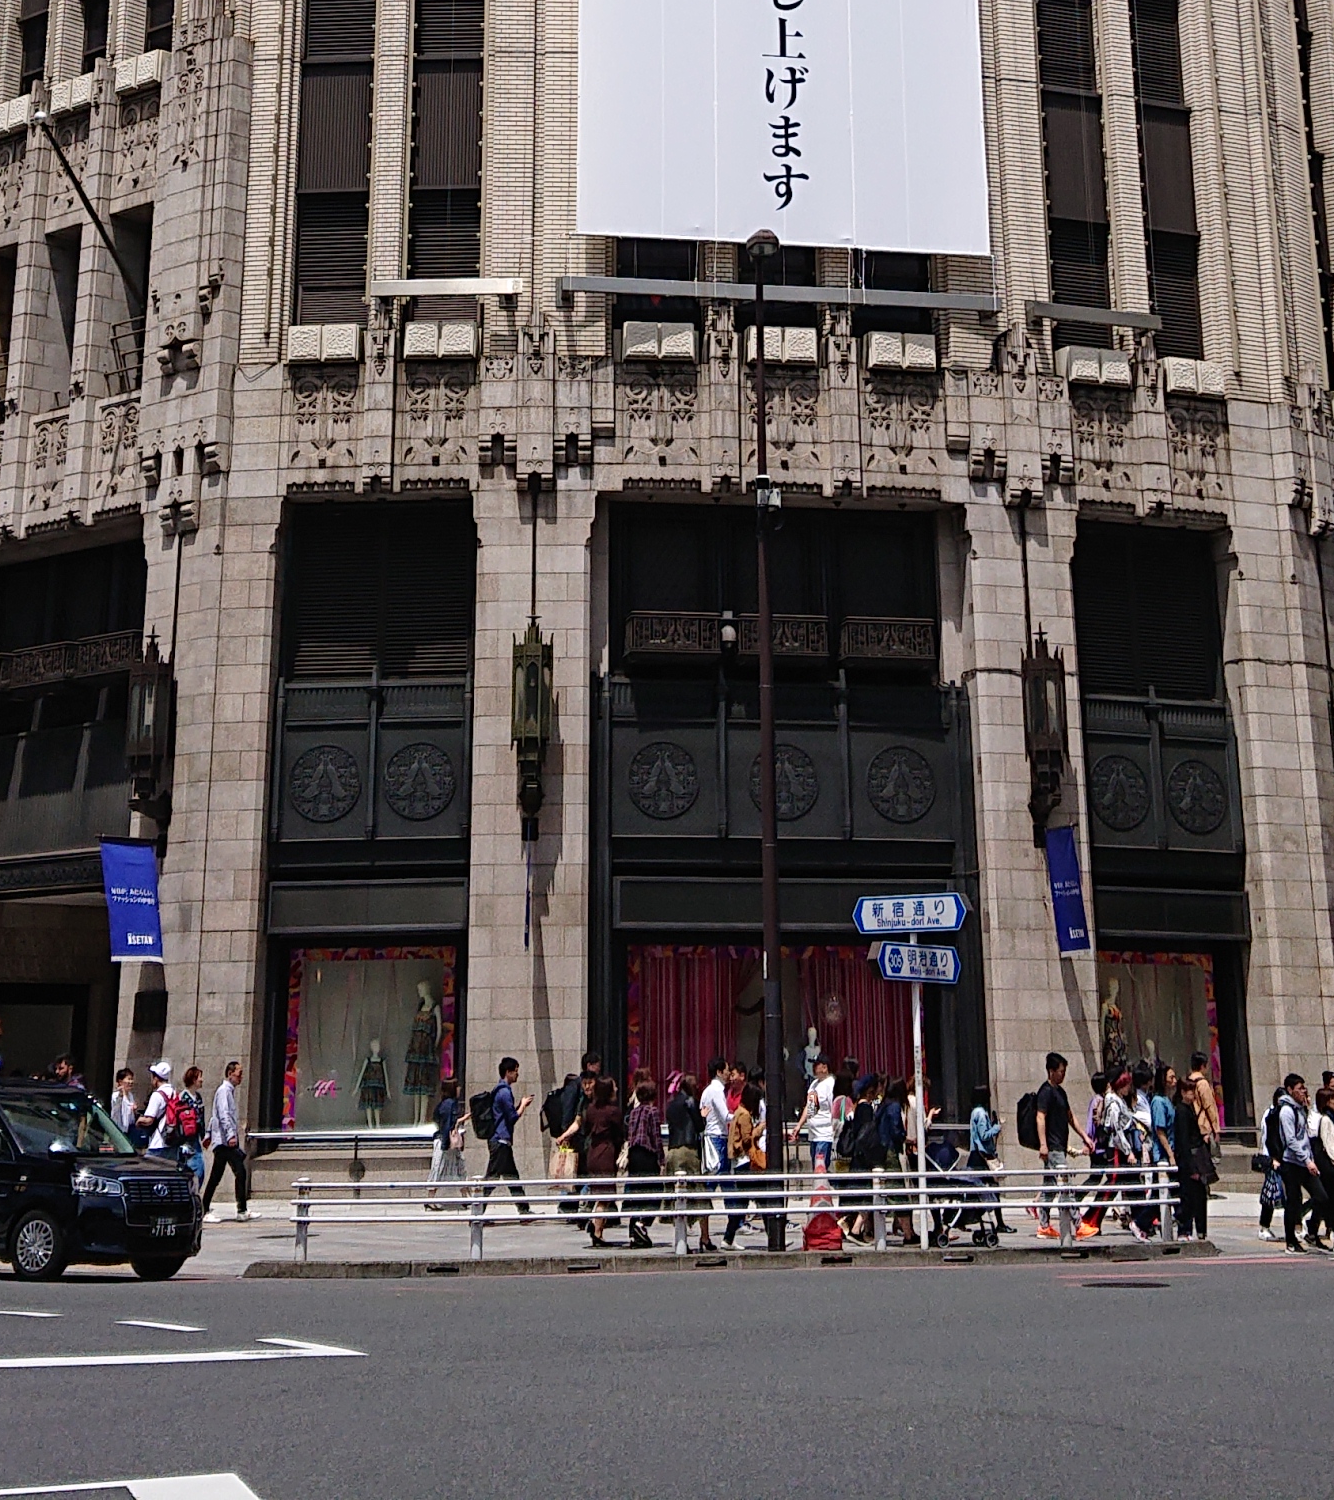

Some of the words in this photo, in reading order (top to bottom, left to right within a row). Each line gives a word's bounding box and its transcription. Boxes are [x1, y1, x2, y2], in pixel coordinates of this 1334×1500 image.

[872, 900, 945, 919] 新宿通り
[877, 918, 925, 928] Shinjuku-dori
[927, 917, 943, 925] Ave.
[127, 932, 153, 945] ISETAN
[889, 954, 903, 967] 305
[907, 949, 948, 967] 明治通り
